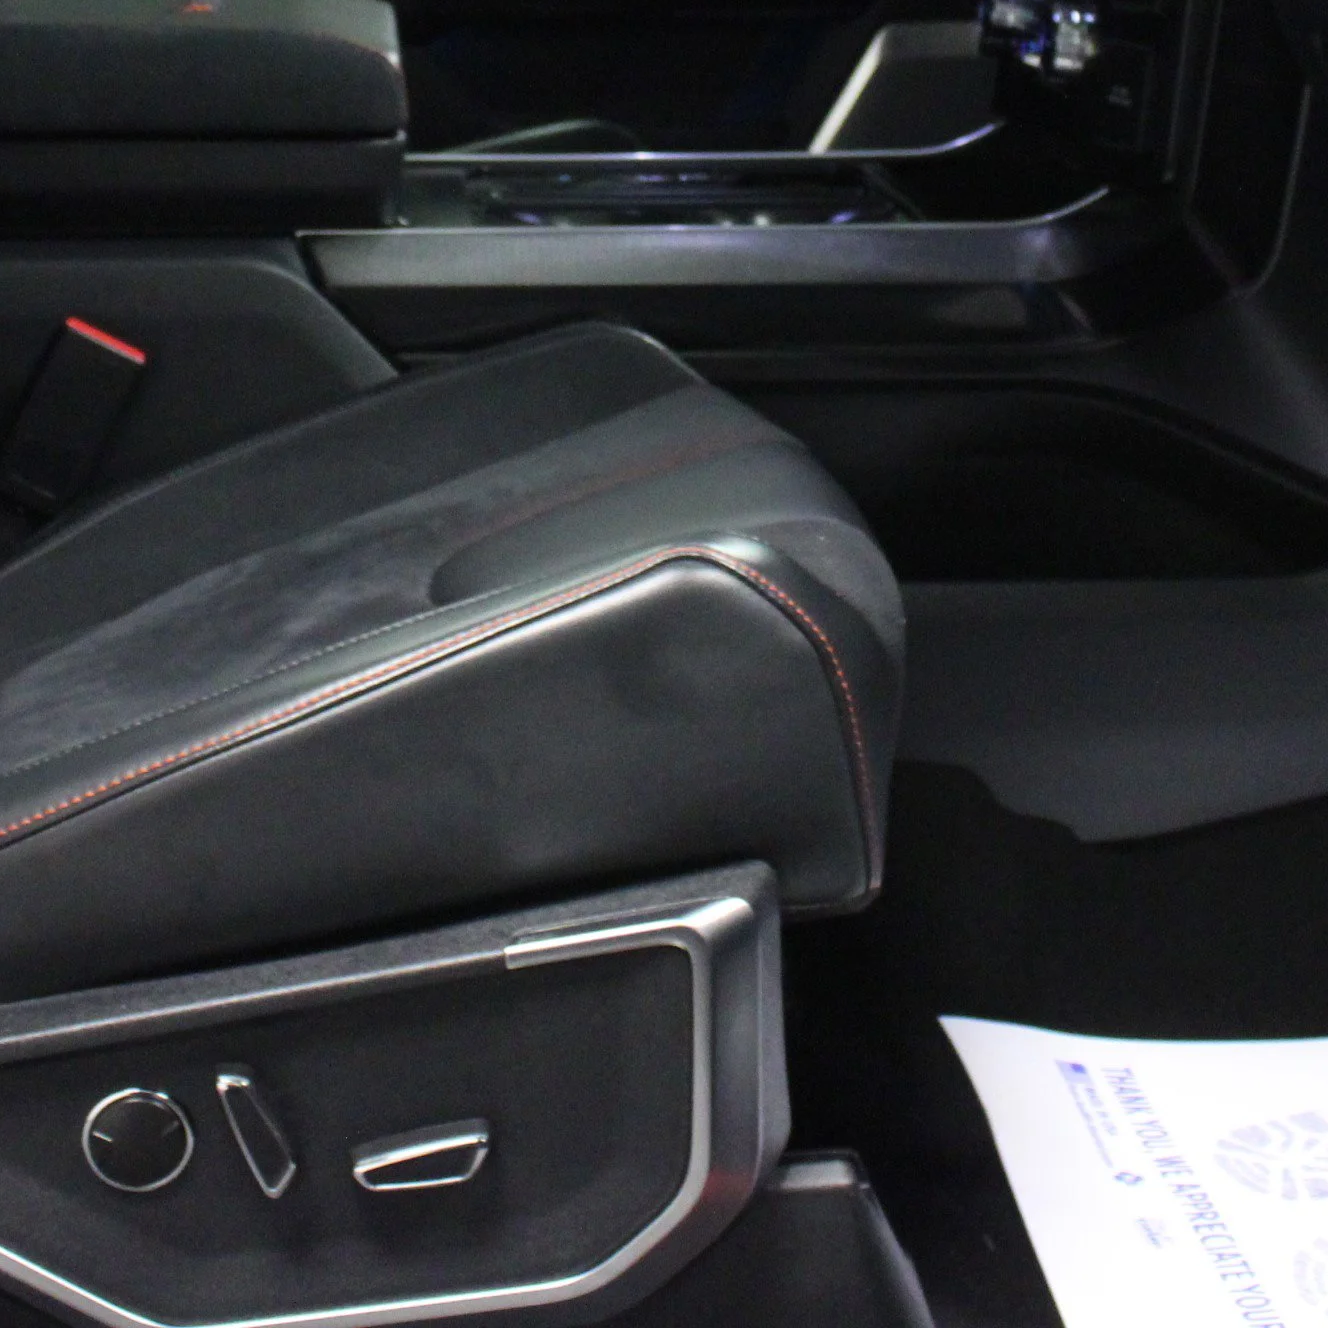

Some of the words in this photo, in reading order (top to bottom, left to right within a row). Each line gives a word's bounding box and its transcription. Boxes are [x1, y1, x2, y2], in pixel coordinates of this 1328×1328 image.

[1101, 1067, 1155, 1114] THANK
[1131, 1119, 1174, 1154] YOU,
[1152, 1155, 1195, 1179] WE
[1168, 1183, 1256, 1281] APPRECIATE
